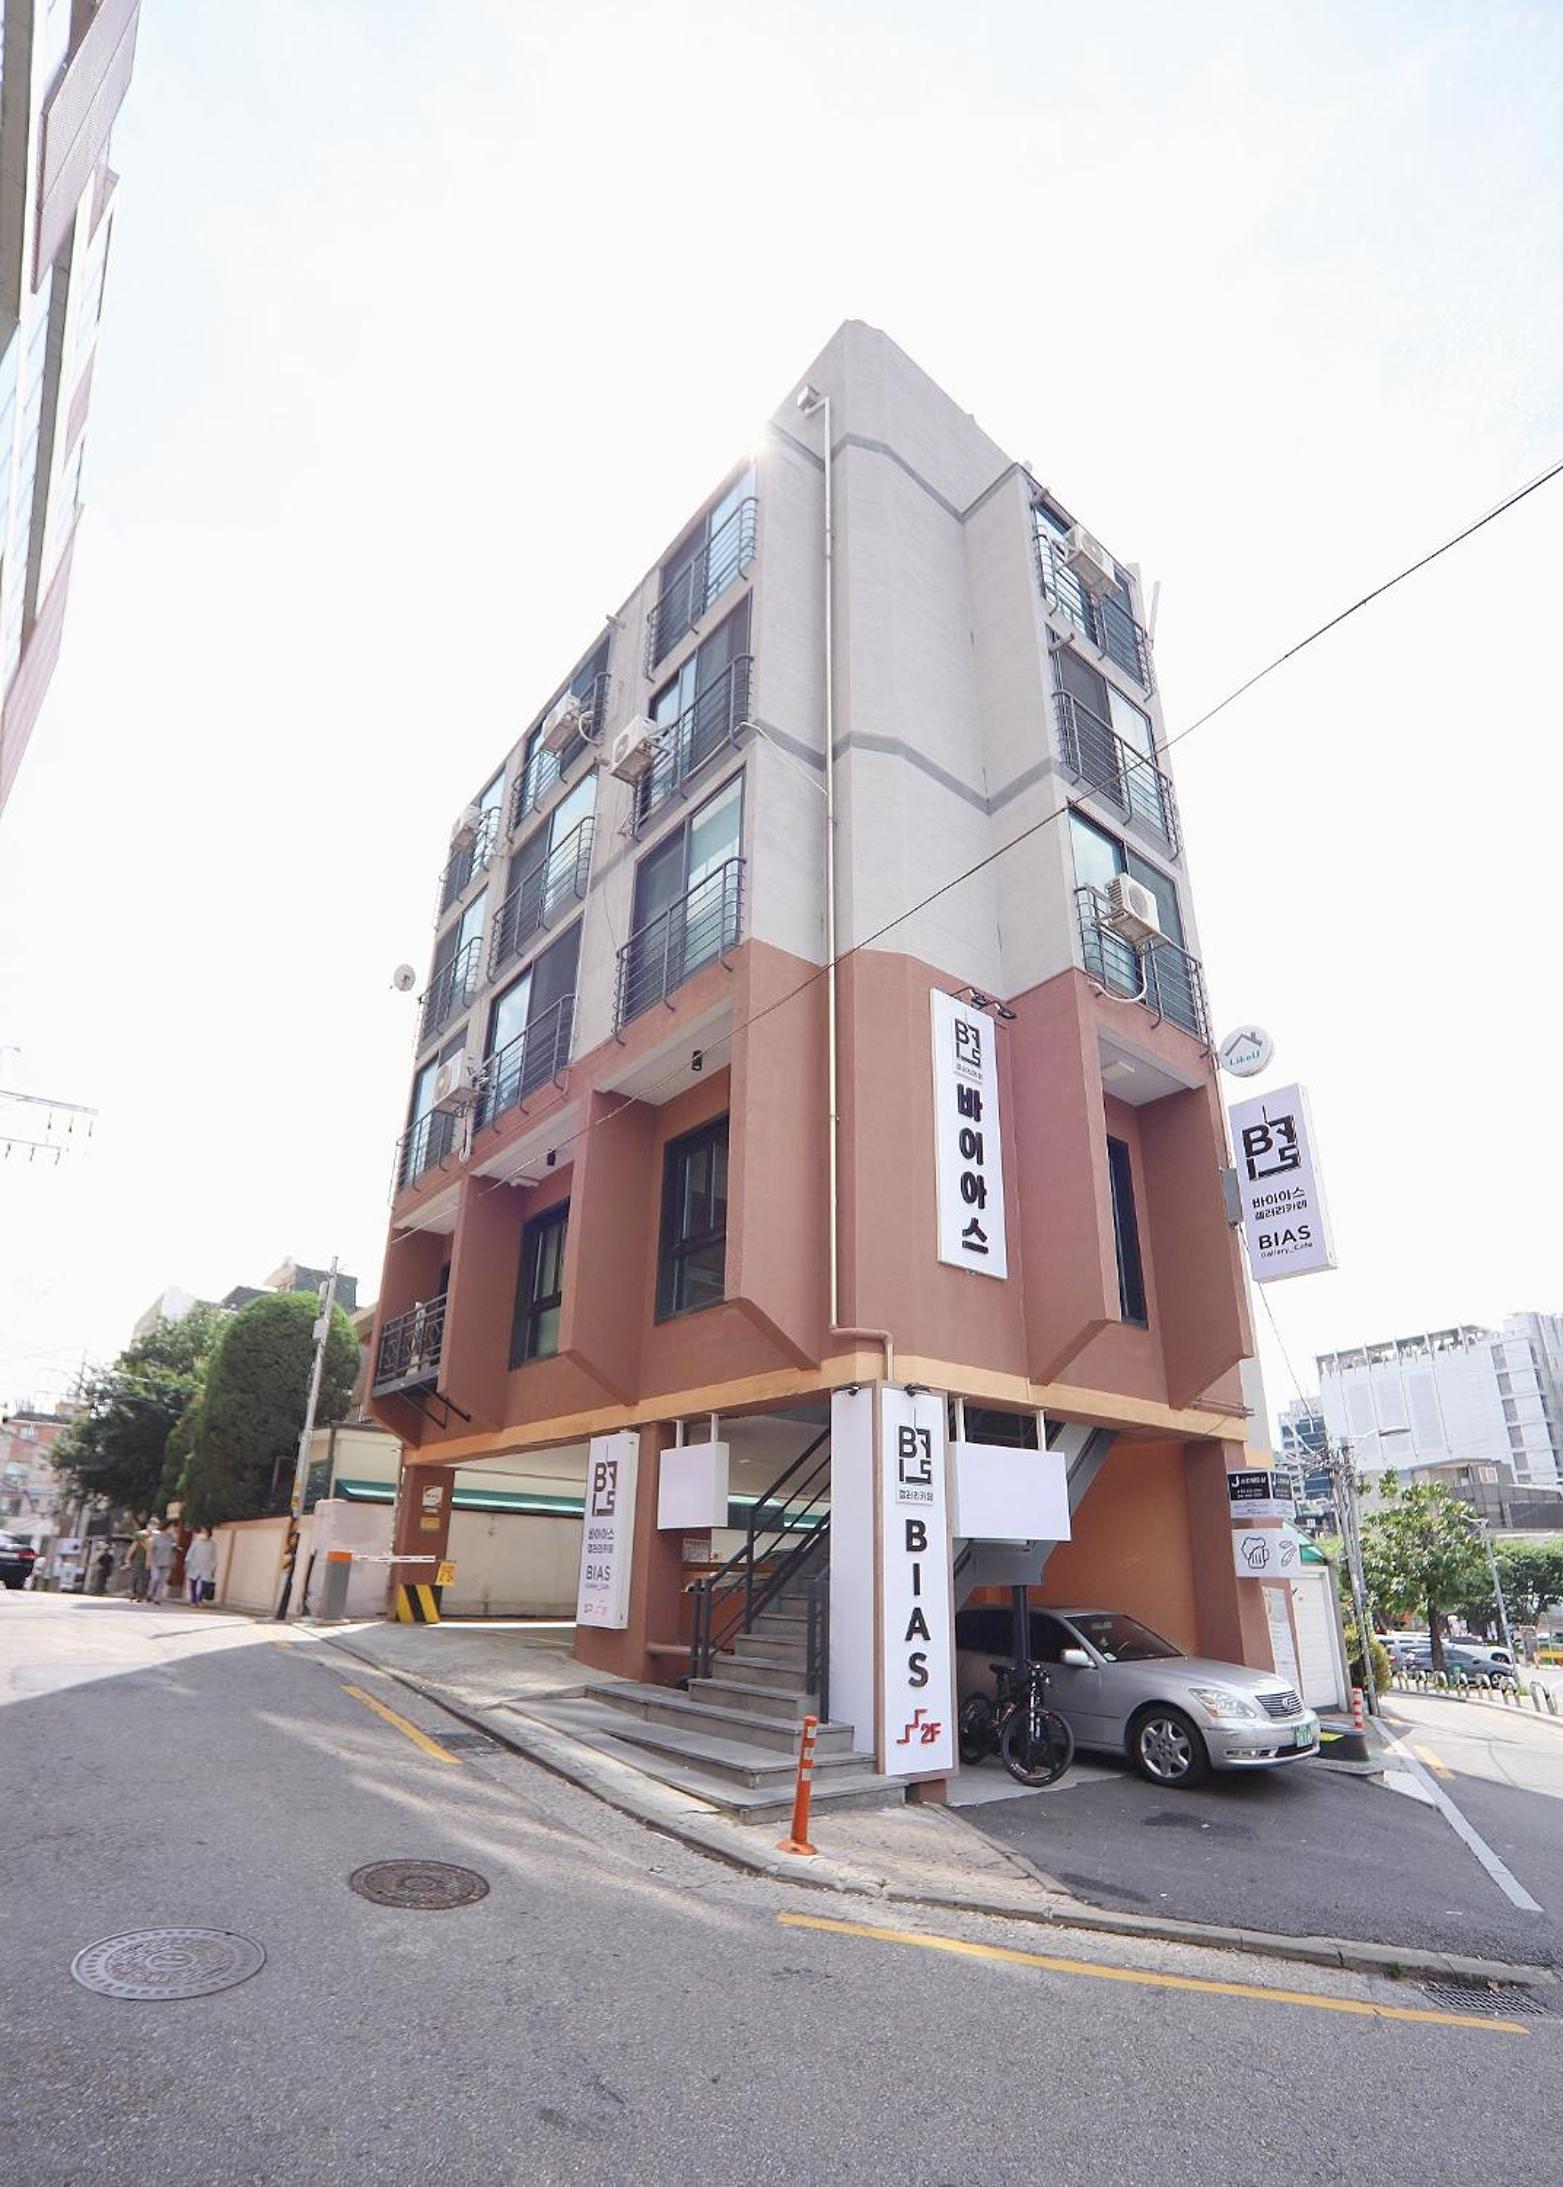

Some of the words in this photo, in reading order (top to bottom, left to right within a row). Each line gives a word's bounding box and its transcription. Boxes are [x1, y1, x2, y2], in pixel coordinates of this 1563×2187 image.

[957, 1083, 989, 1255] 바이아스
[1259, 1225, 1311, 1250] BIAS
[586, 1565, 610, 1581] BIAS
[905, 1519, 931, 1688] BIAS
[921, 1723, 941, 1744] 2F
